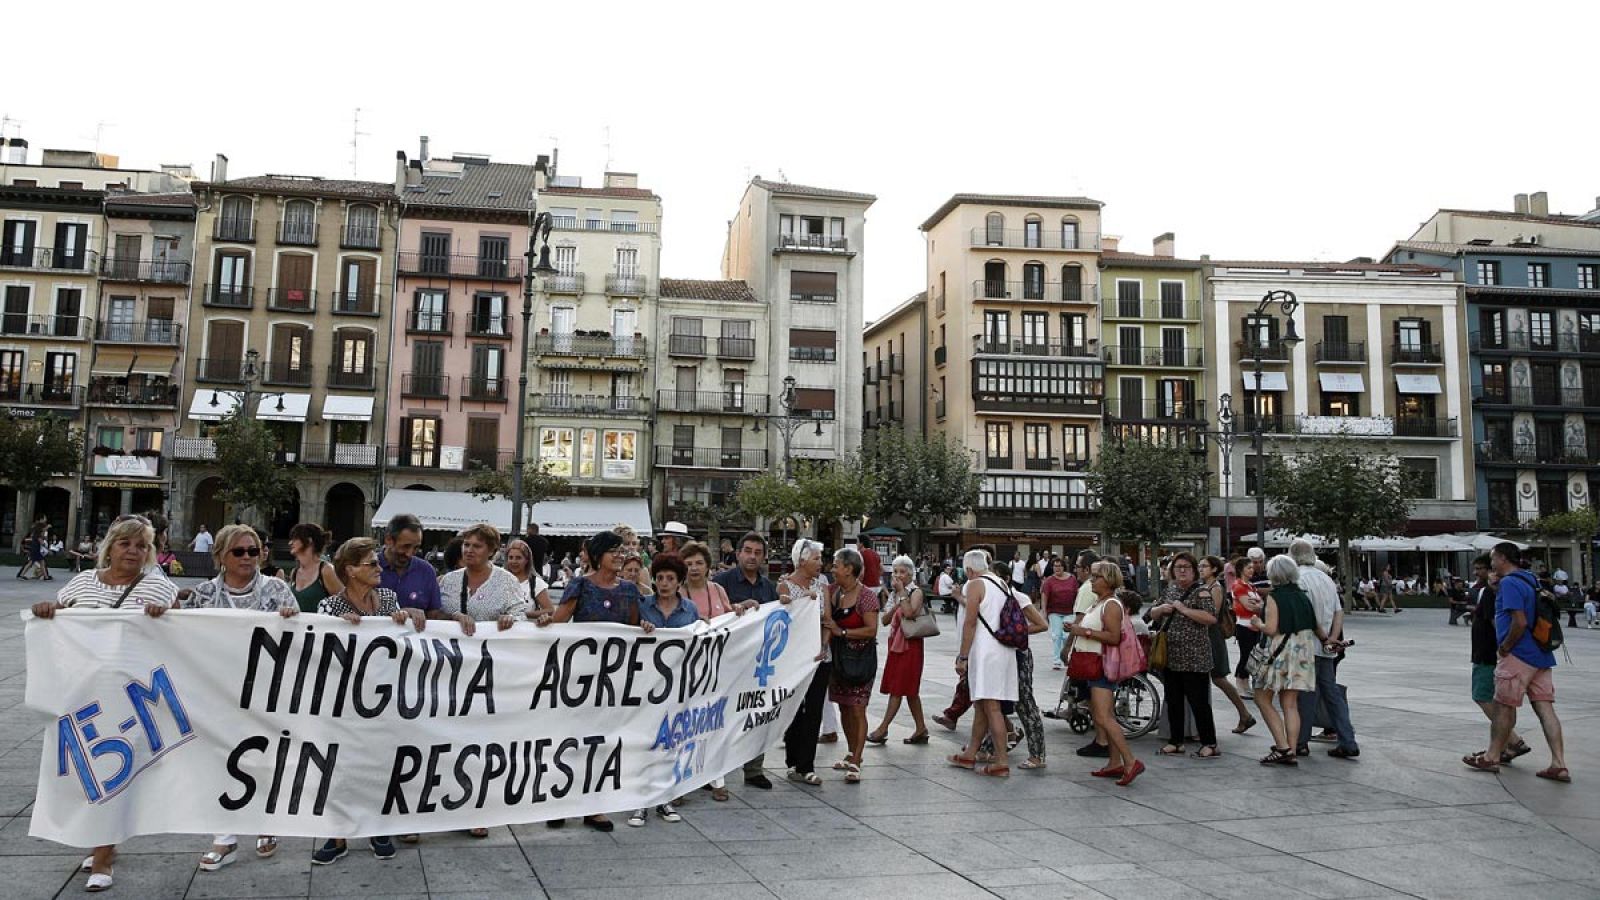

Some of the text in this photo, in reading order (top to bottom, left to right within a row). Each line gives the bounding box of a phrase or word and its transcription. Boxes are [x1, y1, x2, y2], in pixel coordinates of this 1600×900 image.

[240, 625, 495, 719] NINGUNA
[57, 664, 194, 804] 15-M
[218, 730, 623, 816] SIN RESPUESTA
